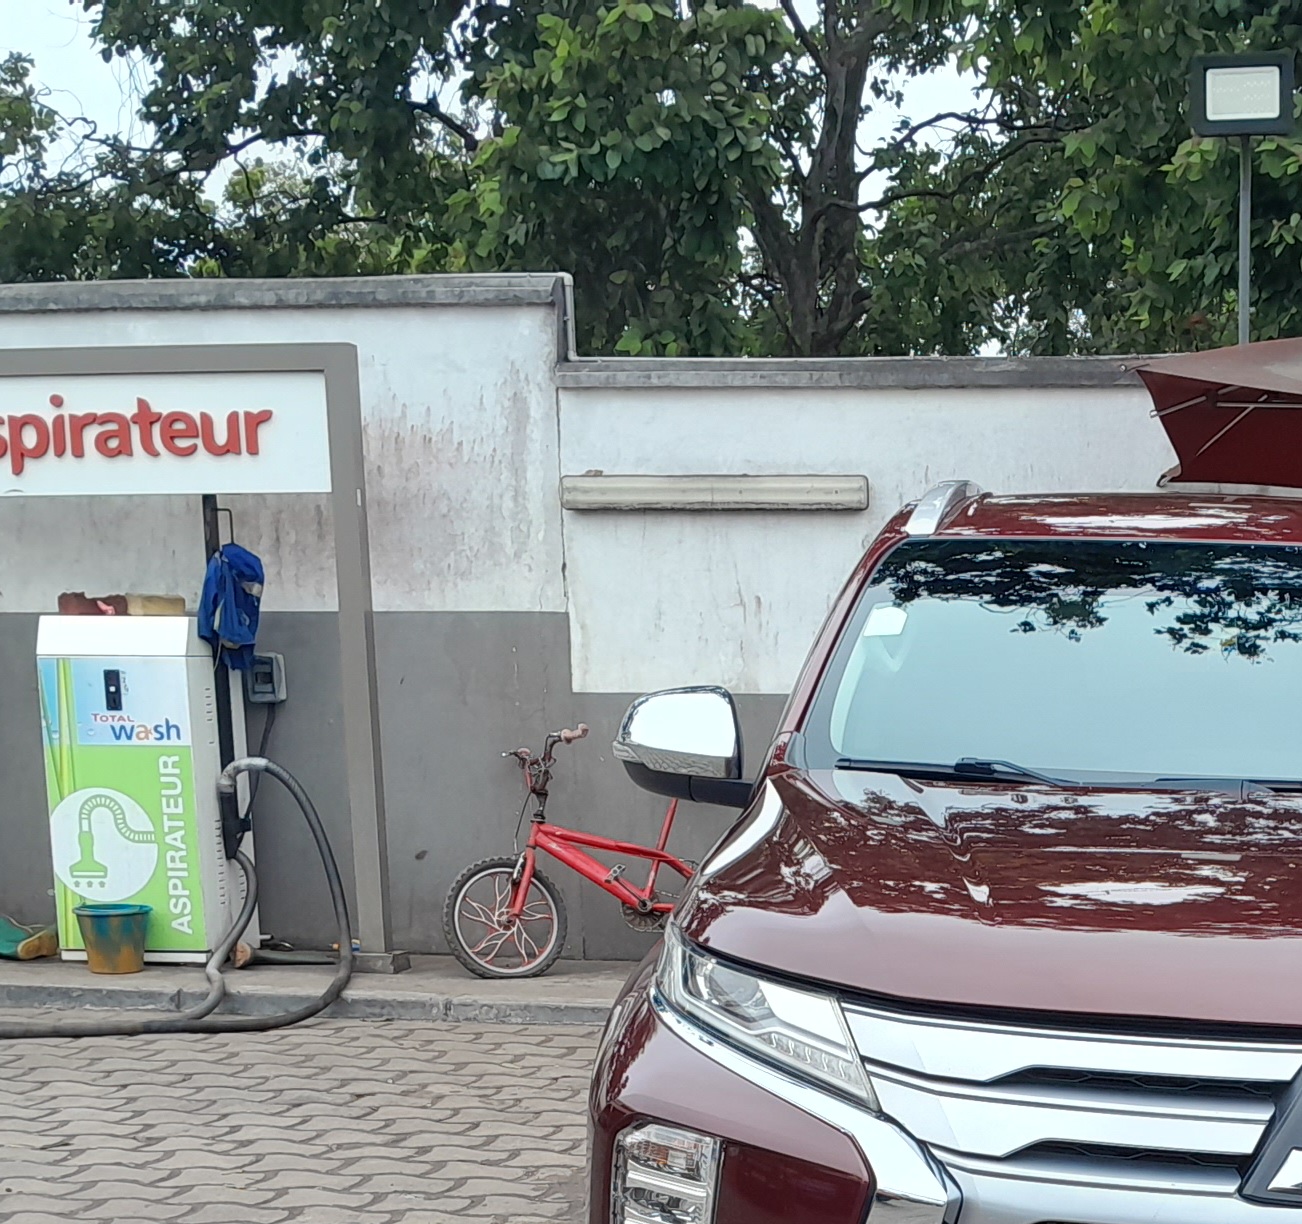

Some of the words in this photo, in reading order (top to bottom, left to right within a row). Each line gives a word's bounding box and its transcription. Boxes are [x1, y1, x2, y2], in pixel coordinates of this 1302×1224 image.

[0, 394, 272, 475] pirateur
[91, 713, 135, 723] TOTAL
[110, 717, 181, 741] wash
[158, 755, 193, 935] ASPIRATEUR
